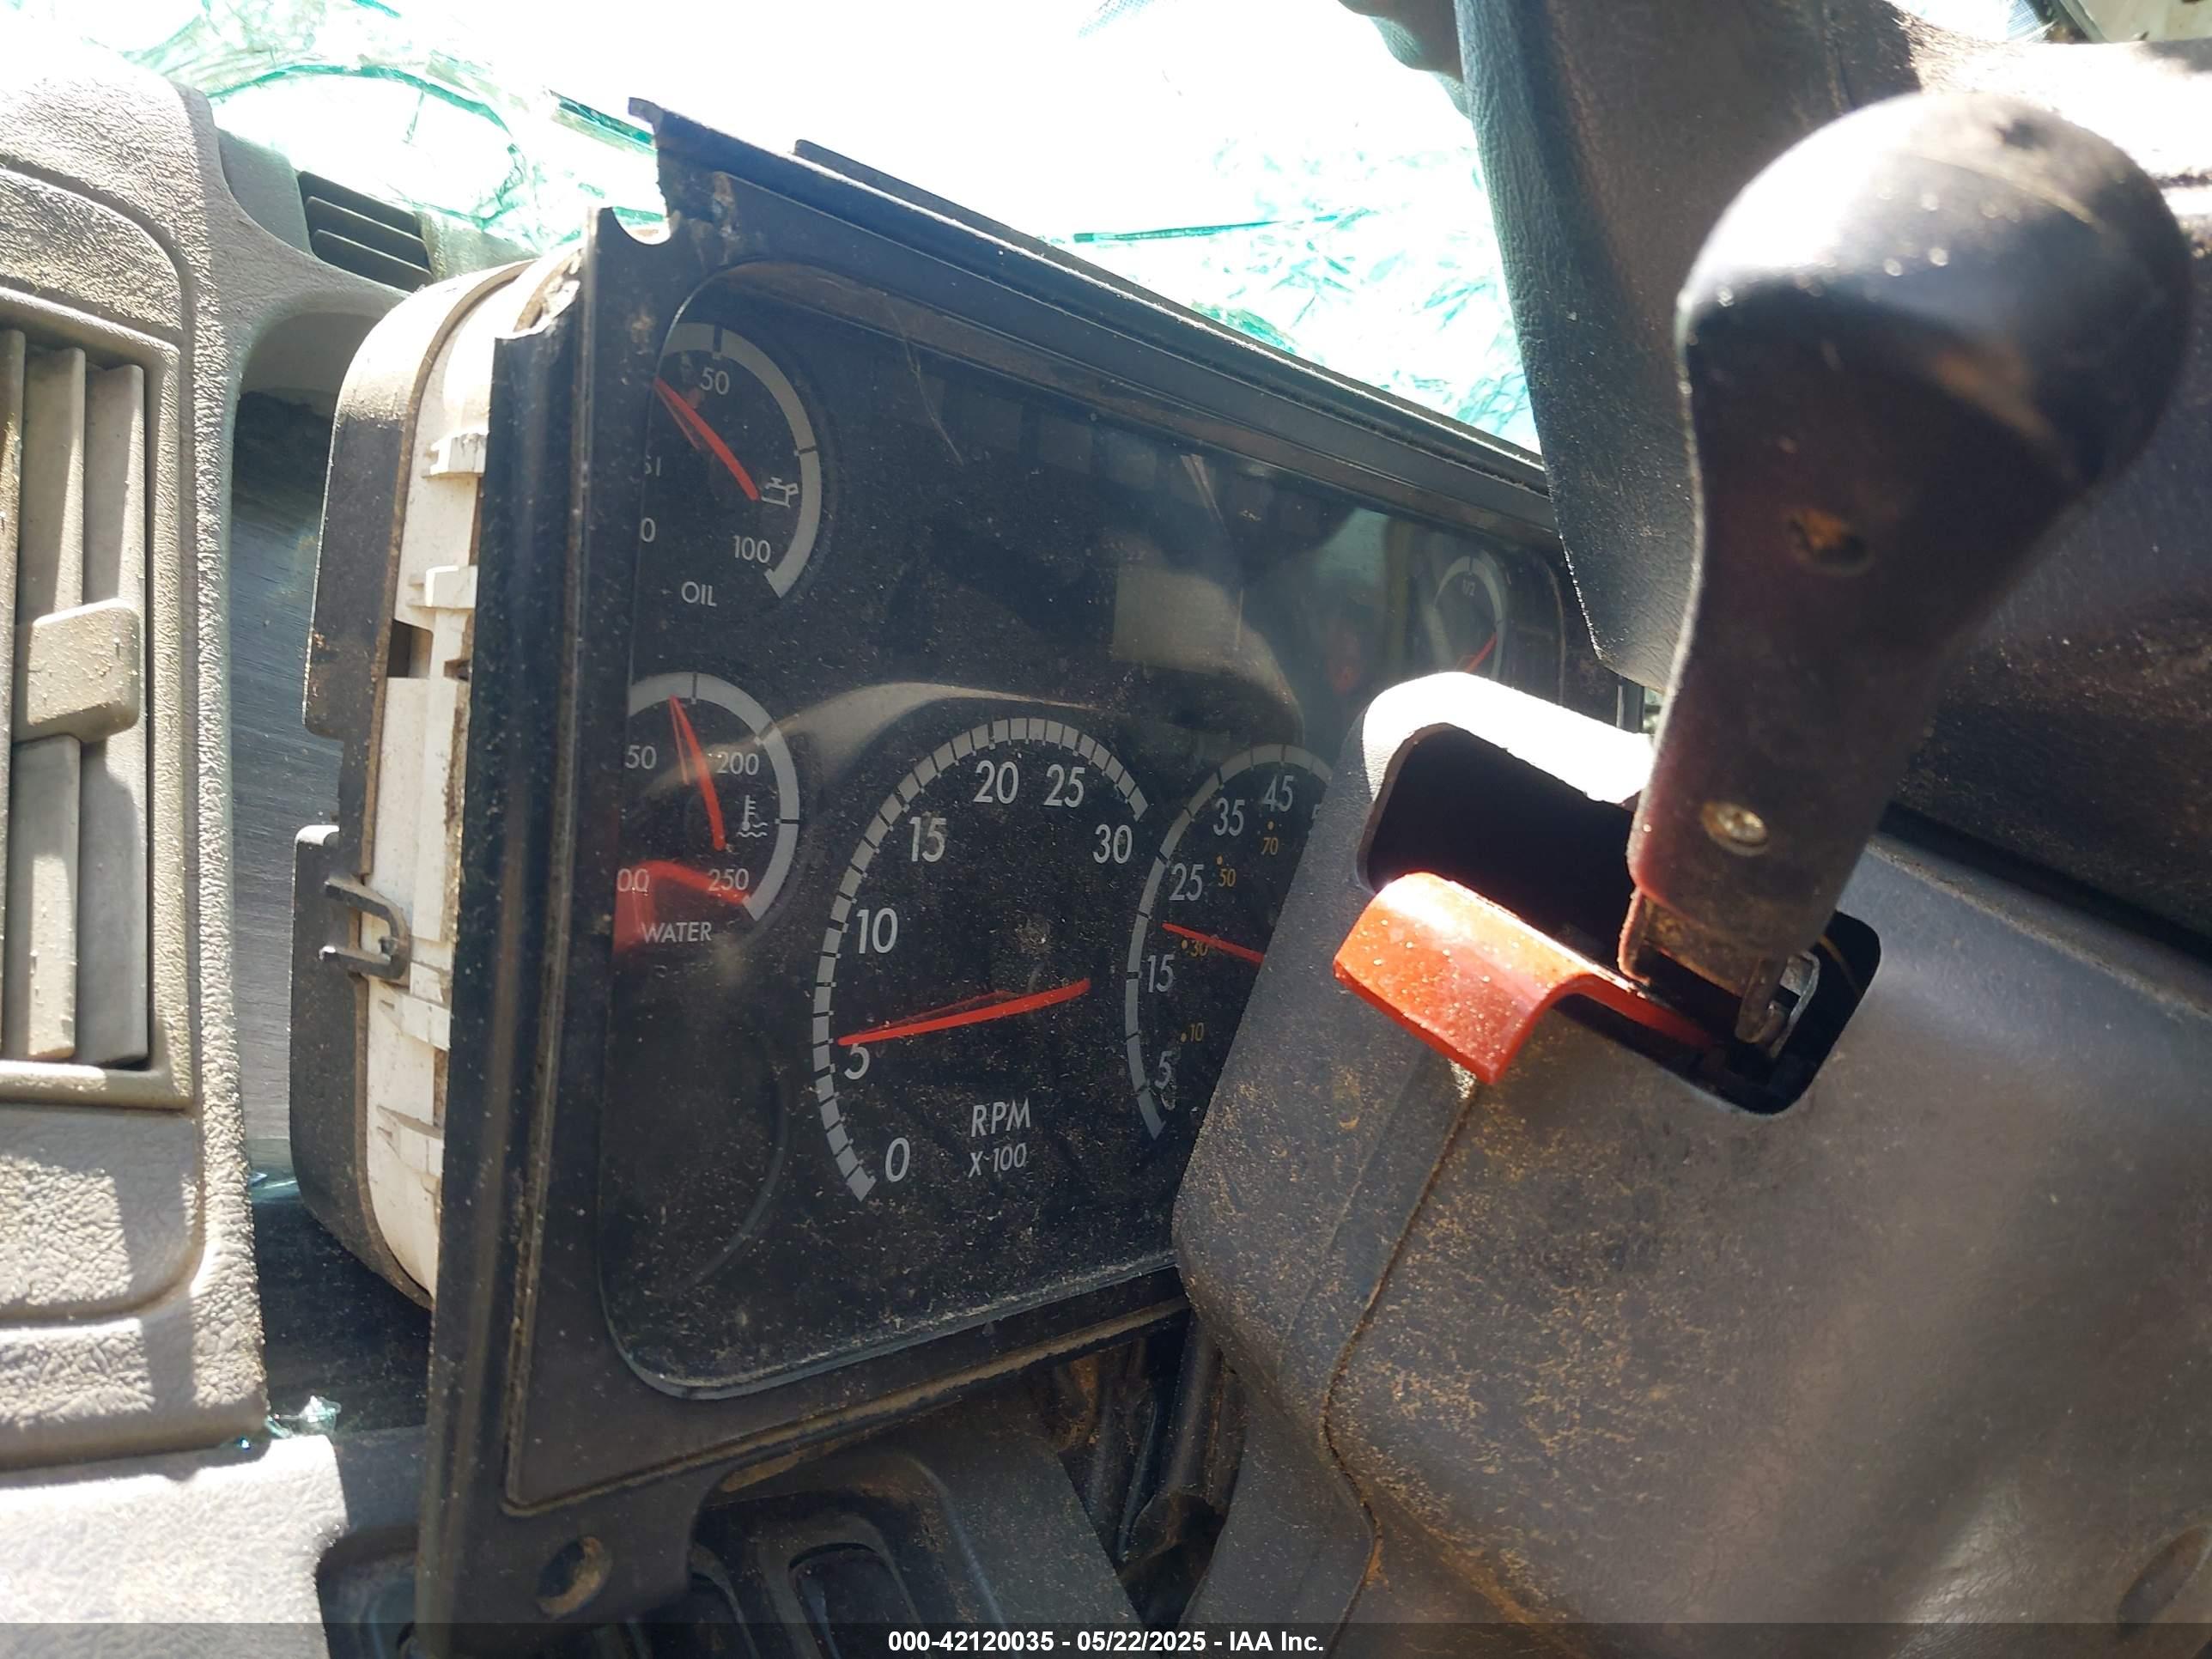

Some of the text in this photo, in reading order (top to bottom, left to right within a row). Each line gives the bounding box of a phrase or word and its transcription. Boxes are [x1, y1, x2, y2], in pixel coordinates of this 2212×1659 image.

[700, 369, 729, 395] 50
[640, 517, 656, 543] 0
[733, 535, 771, 563] 100
[681, 580, 717, 606] OIL
[717, 750, 759, 775] 200
[974, 760, 1019, 805] 20
[1044, 764, 1085, 808] 25
[1263, 775, 1294, 812] 45
[1212, 797, 1245, 836] 35
[909, 816, 947, 862] 15
[1093, 823, 1133, 864] 30
[1261, 836, 1279, 855] 70
[708, 867, 749, 891] 250
[1170, 863, 1204, 902] 25
[1218, 867, 1237, 888] 50
[642, 921, 713, 944] WATER
[856, 907, 898, 955] 10
[1146, 953, 1175, 994] 15
[1189, 1022, 1205, 1042] 10
[843, 1043, 871, 1080] 5
[1154, 1050, 1173, 1090] 5
[970, 1098, 1030, 1138] RPM
[885, 1137, 910, 1182] 0
[993, 1143, 1027, 1171] 100
